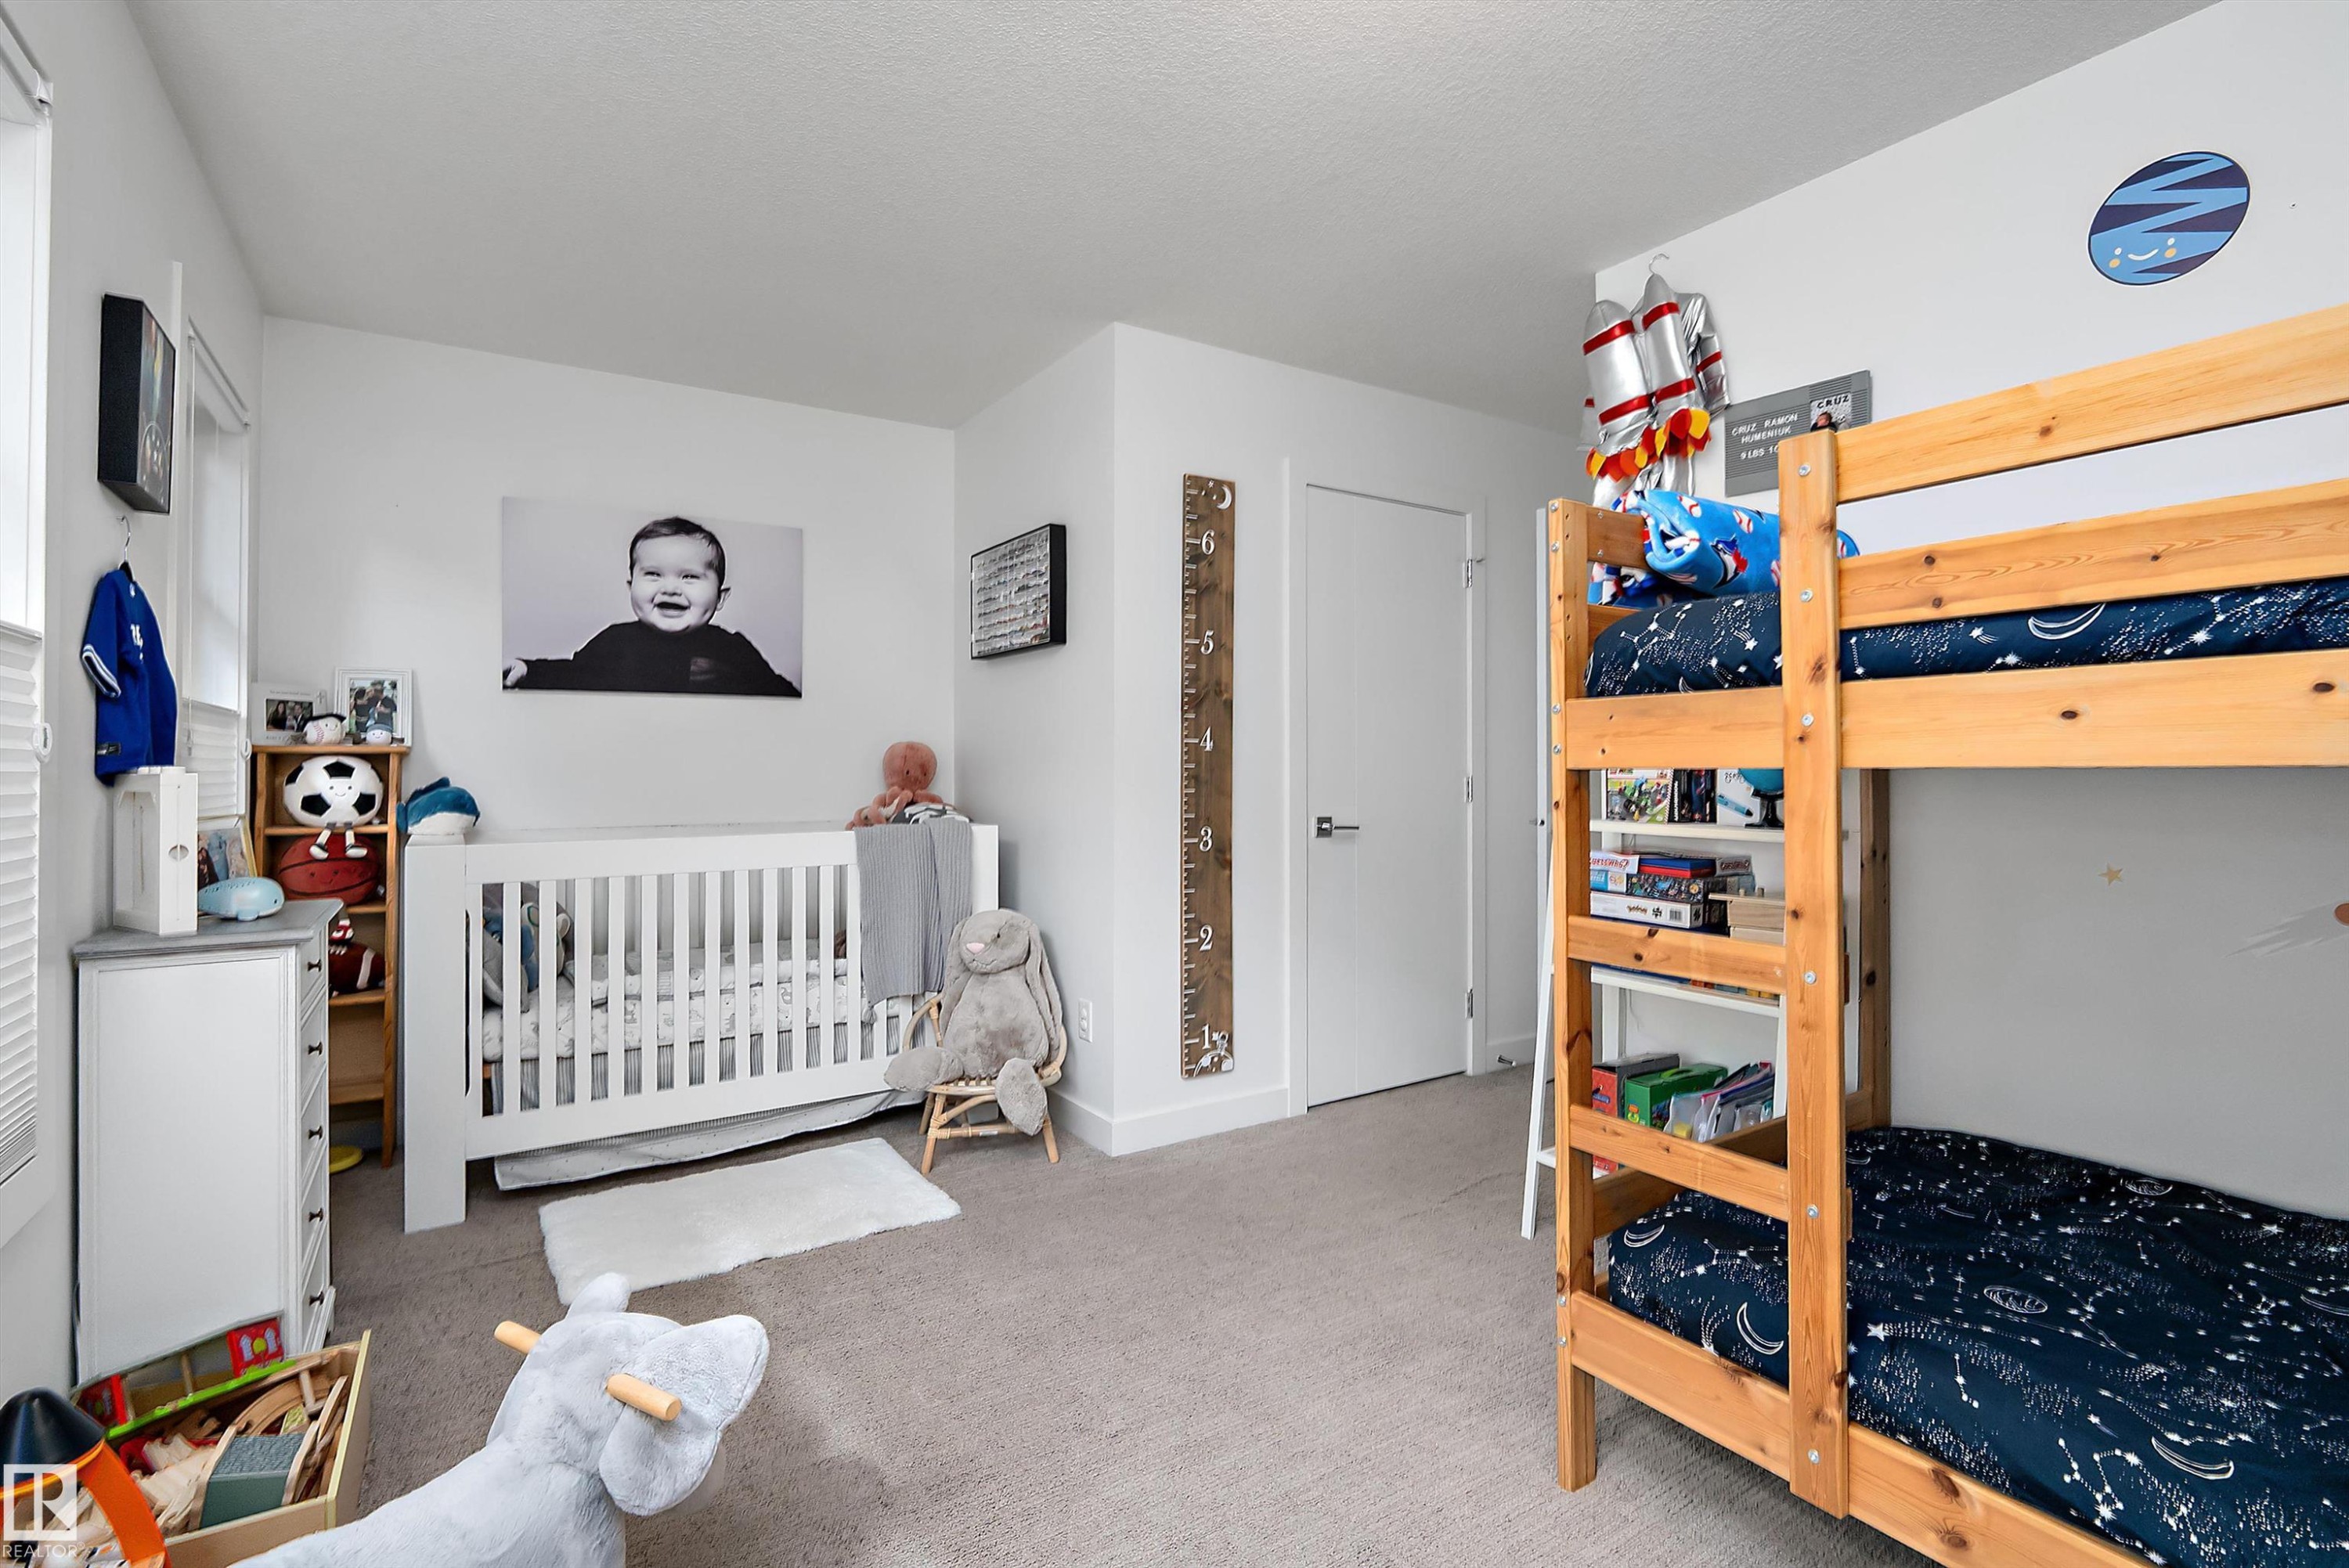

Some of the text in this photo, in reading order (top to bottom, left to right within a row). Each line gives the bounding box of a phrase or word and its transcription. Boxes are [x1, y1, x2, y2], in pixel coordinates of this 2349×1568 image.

[1817, 395, 1849, 409] CRUZ
[1731, 413, 1799, 437] CRUZ RAMON
[1741, 425, 1792, 444] HUMENIUK
[1740, 451, 1747, 460] 9
[1748, 448, 1765, 459] LBS
[1201, 529, 1215, 555] 6
[1200, 629, 1214, 654] 5
[1200, 726, 1214, 752] 4
[1199, 825, 1213, 852] 3
[1200, 924, 1213, 951] 2
[1201, 1023, 1211, 1050] 1
